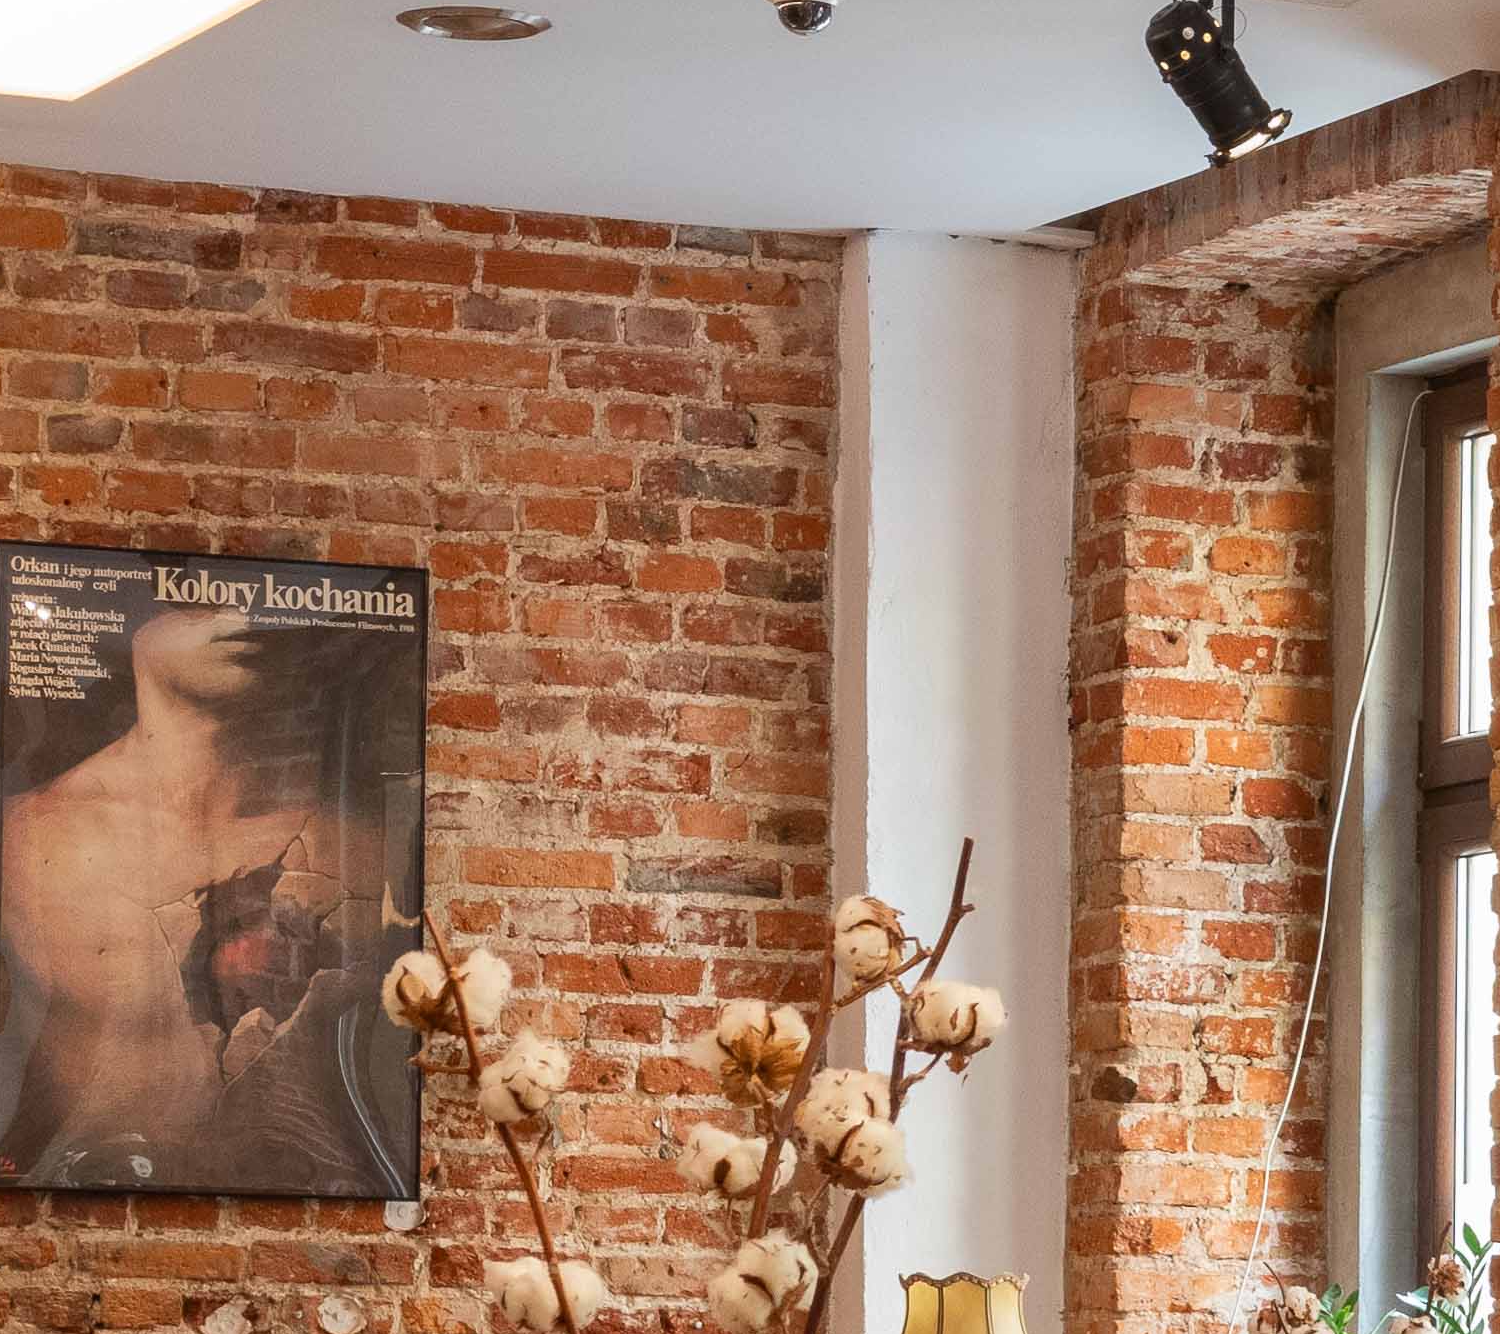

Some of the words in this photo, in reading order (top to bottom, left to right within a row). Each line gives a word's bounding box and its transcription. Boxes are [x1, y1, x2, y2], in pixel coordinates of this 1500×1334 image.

[10, 555, 60, 574] Orkan
[68, 564, 91, 577] jego
[94, 567, 152, 580] autoportret
[12, 575, 84, 591] udoskonalony
[92, 580, 117, 593] czyli
[153, 566, 259, 613] Kolory
[263, 574, 416, 618] kochania
[52, 606, 125, 623] Jakubowska
[10, 629, 18, 638] w
[49, 618, 82, 632] Maciej
[83, 620, 124, 634] Kijowski
[9, 639, 39, 650] Jacek
[10, 650, 40, 663] Maria
[8, 685, 41, 698] Sylwia
